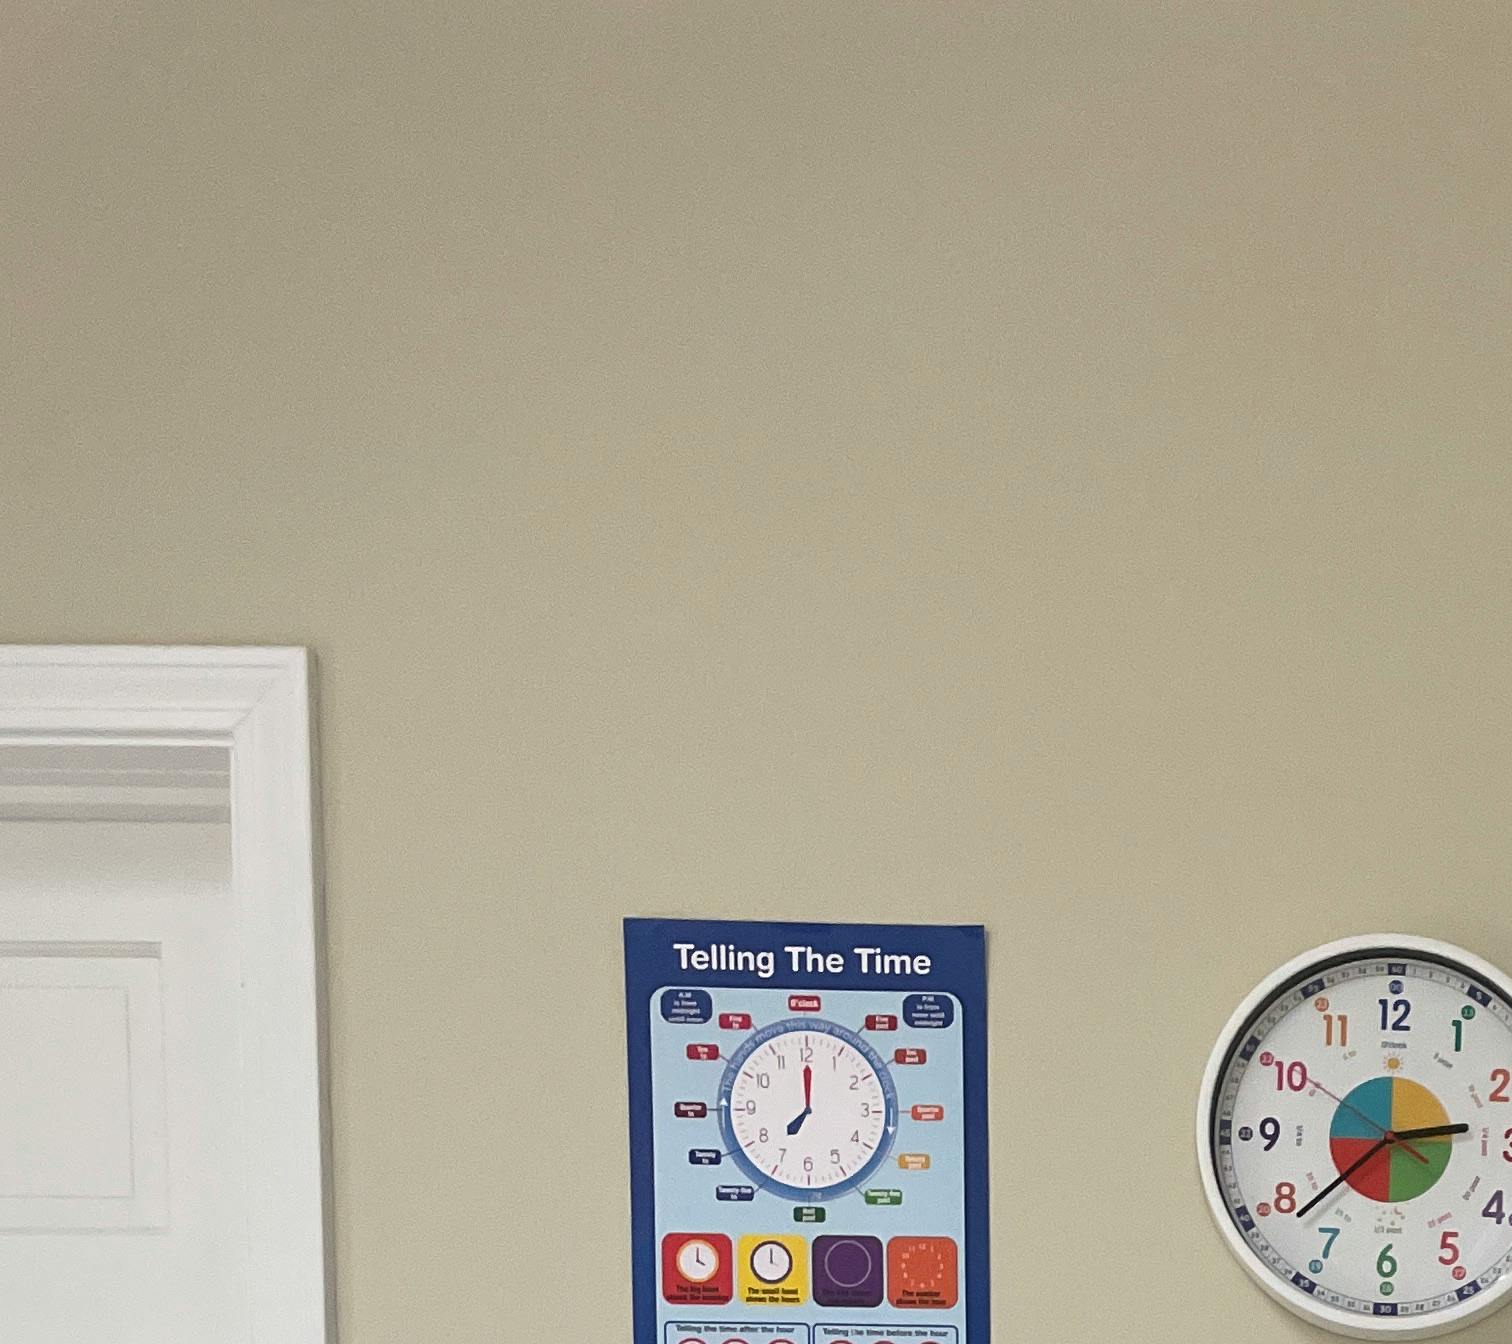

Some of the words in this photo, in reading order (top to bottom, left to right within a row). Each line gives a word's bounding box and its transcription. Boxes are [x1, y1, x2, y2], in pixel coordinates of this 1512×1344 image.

[673, 944, 775, 978] Telling
[784, 946, 844, 973] The
[853, 947, 932, 975] Time
[1378, 998, 1411, 1031] 12
[1323, 1014, 1347, 1047] 11
[1451, 1019, 1462, 1052] 1
[778, 1055, 785, 1070] 11
[800, 1047, 813, 1062] 12
[832, 1056, 836, 1072] 1
[757, 1073, 770, 1089] 10
[849, 1075, 858, 1090] 2
[1275, 1061, 1307, 1092] 10
[1488, 1068, 1510, 1102] 2
[746, 1100, 756, 1115] 9
[861, 1103, 870, 1118] 3
[759, 1128, 768, 1143] 8
[851, 1130, 860, 1143] 4
[1259, 1117, 1281, 1152] 9
[778, 1149, 786, 1163] 7
[803, 1157, 813, 1172] 6
[830, 1150, 840, 1164] 5
[1273, 1181, 1296, 1214] 8
[1481, 1189, 1505, 1225] 4
[1318, 1227, 1340, 1259] 7
[1438, 1231, 1459, 1266] 5
[1376, 1243, 1397, 1278] 6
